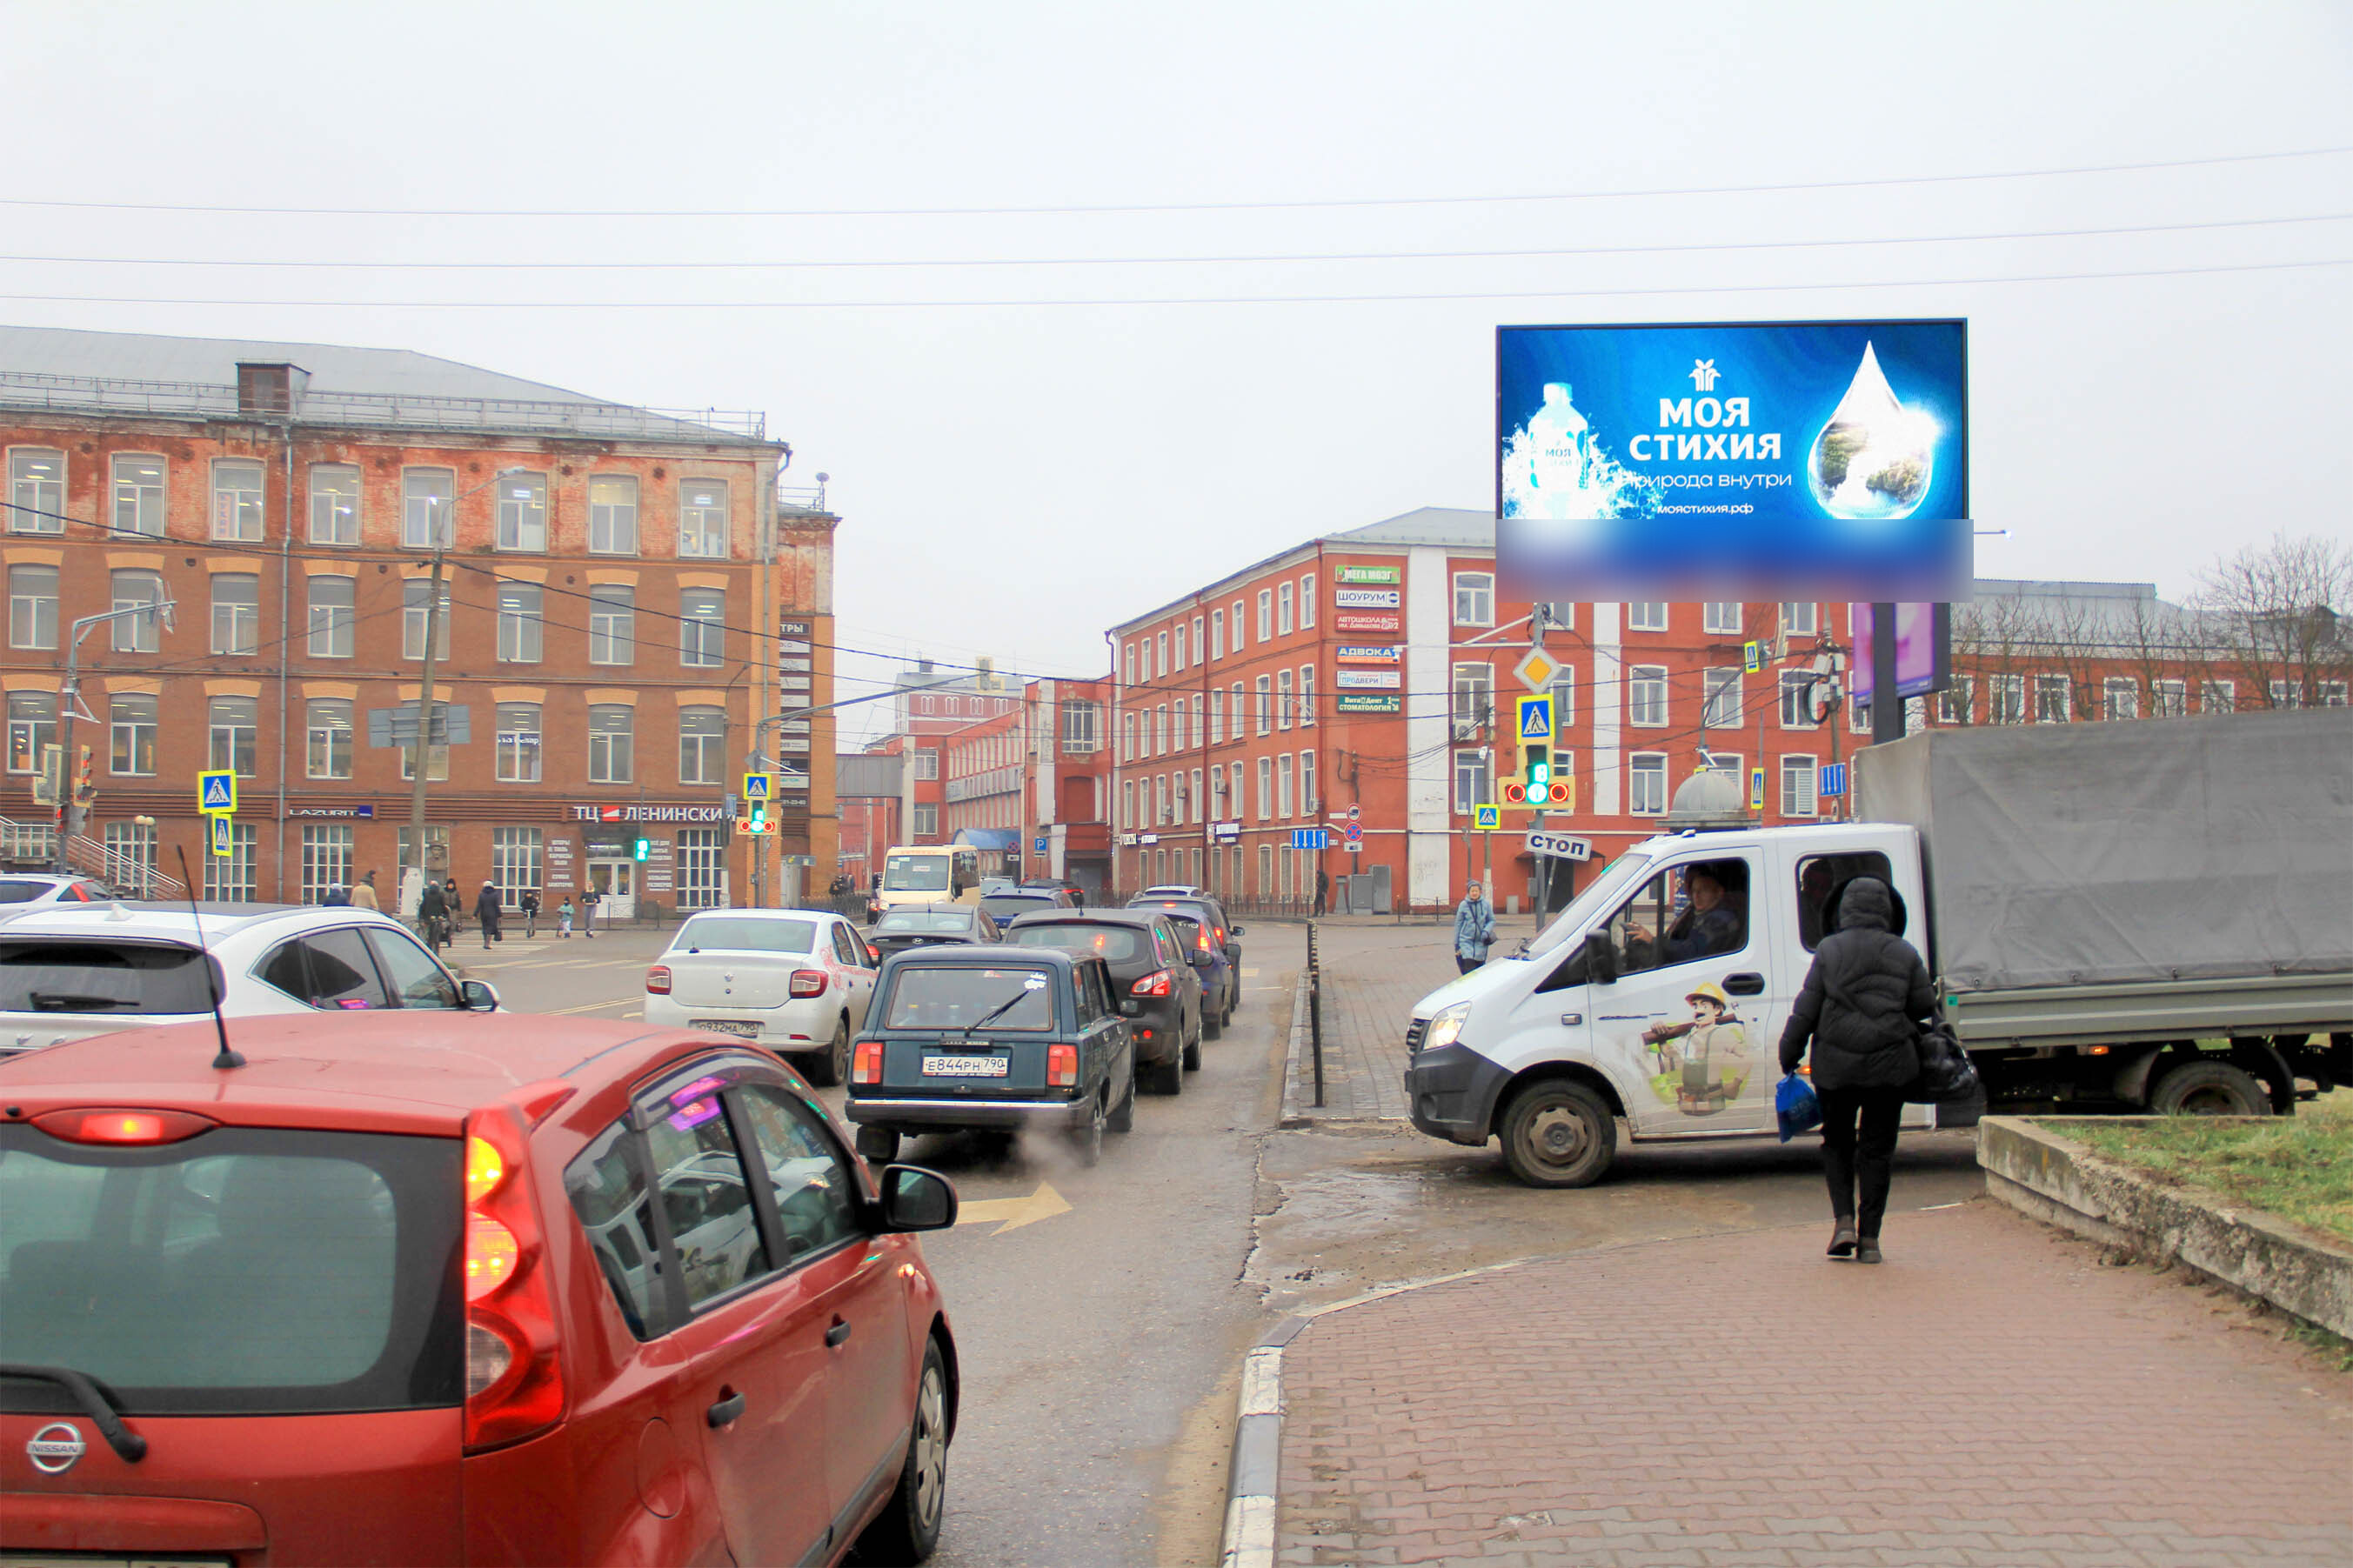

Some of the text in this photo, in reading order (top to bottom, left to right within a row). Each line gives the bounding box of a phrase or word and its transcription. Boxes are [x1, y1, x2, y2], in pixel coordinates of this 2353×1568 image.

[1659, 397, 1750, 429] МОЯ
[1628, 432, 1781, 462] СТИХИЯ
[1718, 473, 1792, 490] внутри
[1657, 503, 1754, 515] моястихия.рф
[1338, 592, 1386, 601] ШОУРУМ
[1338, 647, 1397, 657] АДВОКА
[573, 806, 599, 823] ТЦ
[1530, 835, 1585, 856] СТОП
[927, 1058, 1004, 1071] Е844РН 790
[30, 1444, 79, 1453] NISSAN
